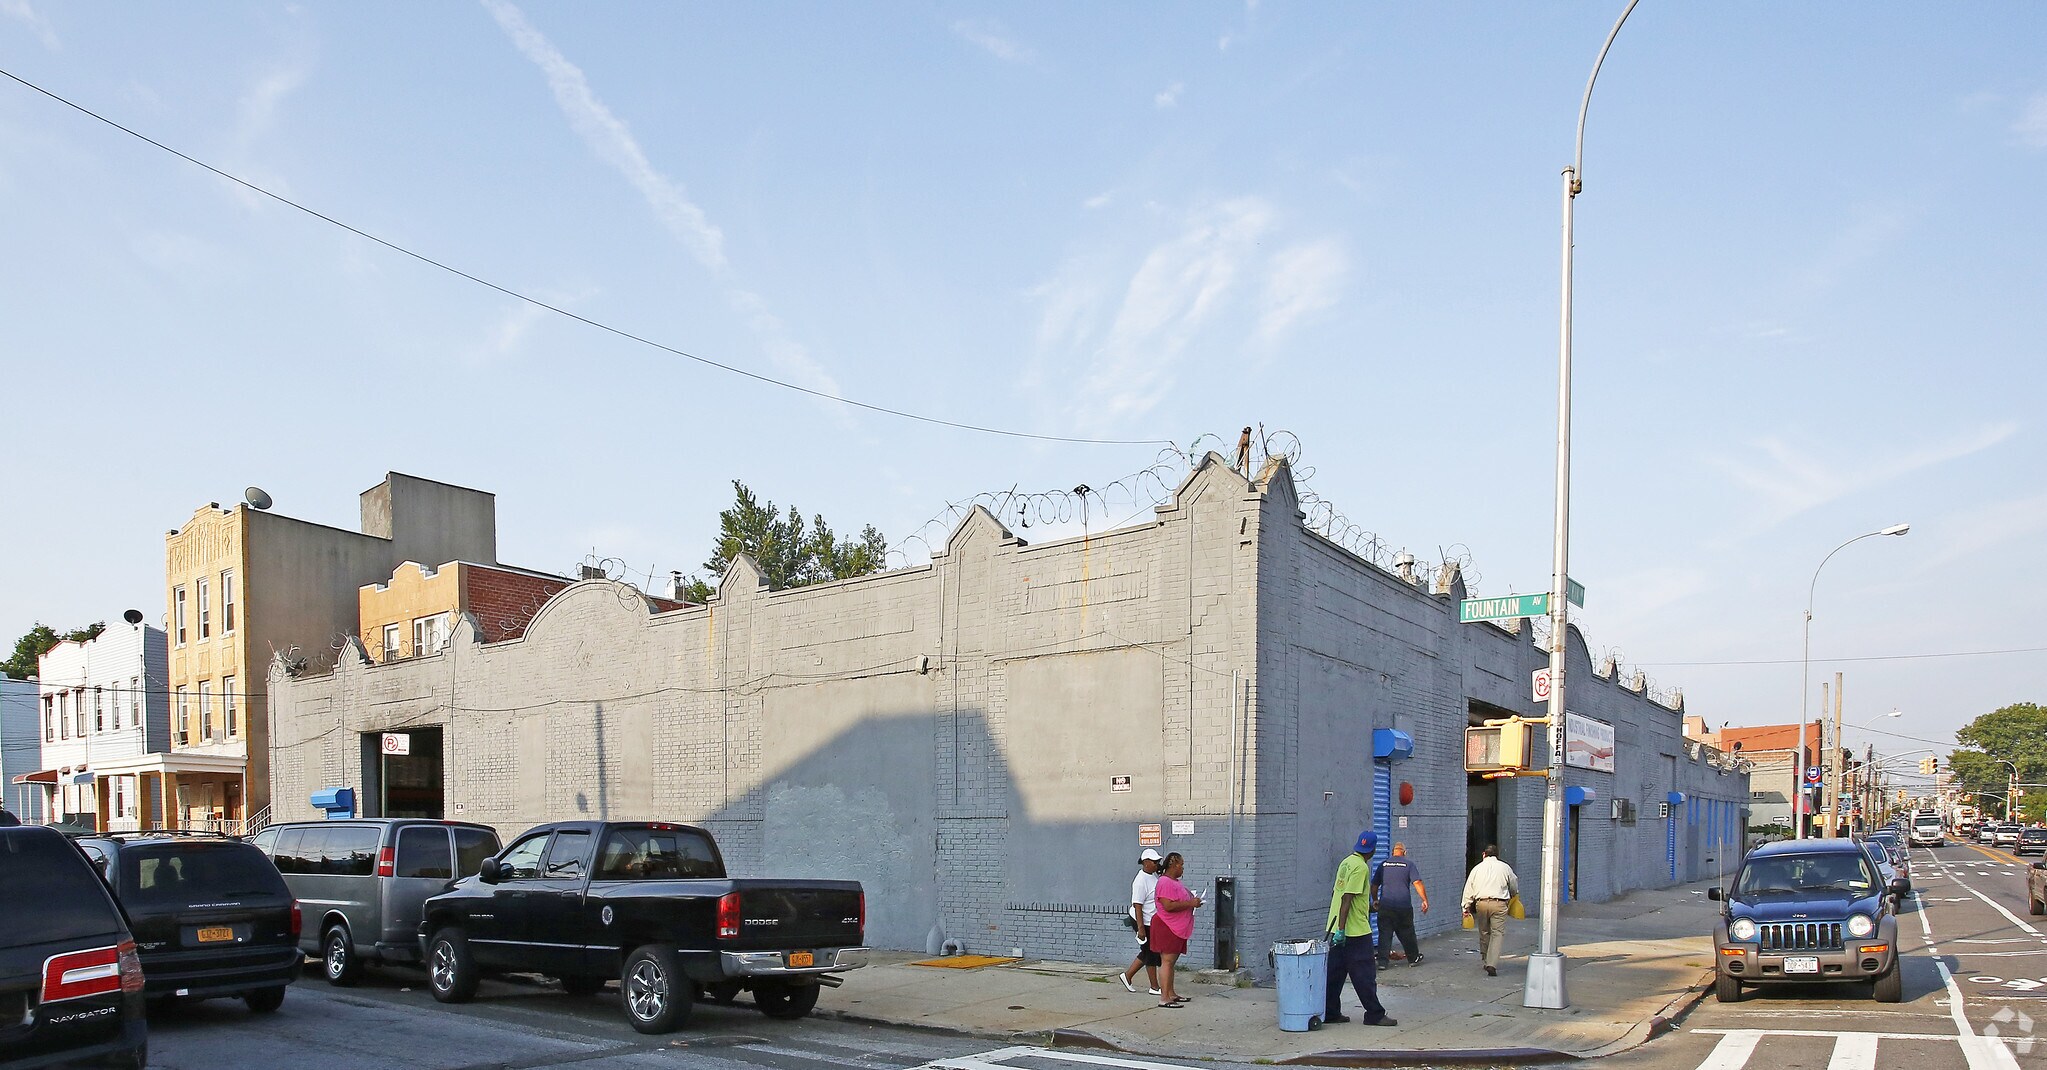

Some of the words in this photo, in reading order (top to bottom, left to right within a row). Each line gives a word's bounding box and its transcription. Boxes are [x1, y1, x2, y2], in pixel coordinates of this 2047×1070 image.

[1465, 598, 1520, 618] FOUNTAIN
[1532, 596, 1542, 606] AV
[1554, 727, 1563, 757] HOFFA
[49, 1006, 116, 1024] NAVIGATOR
